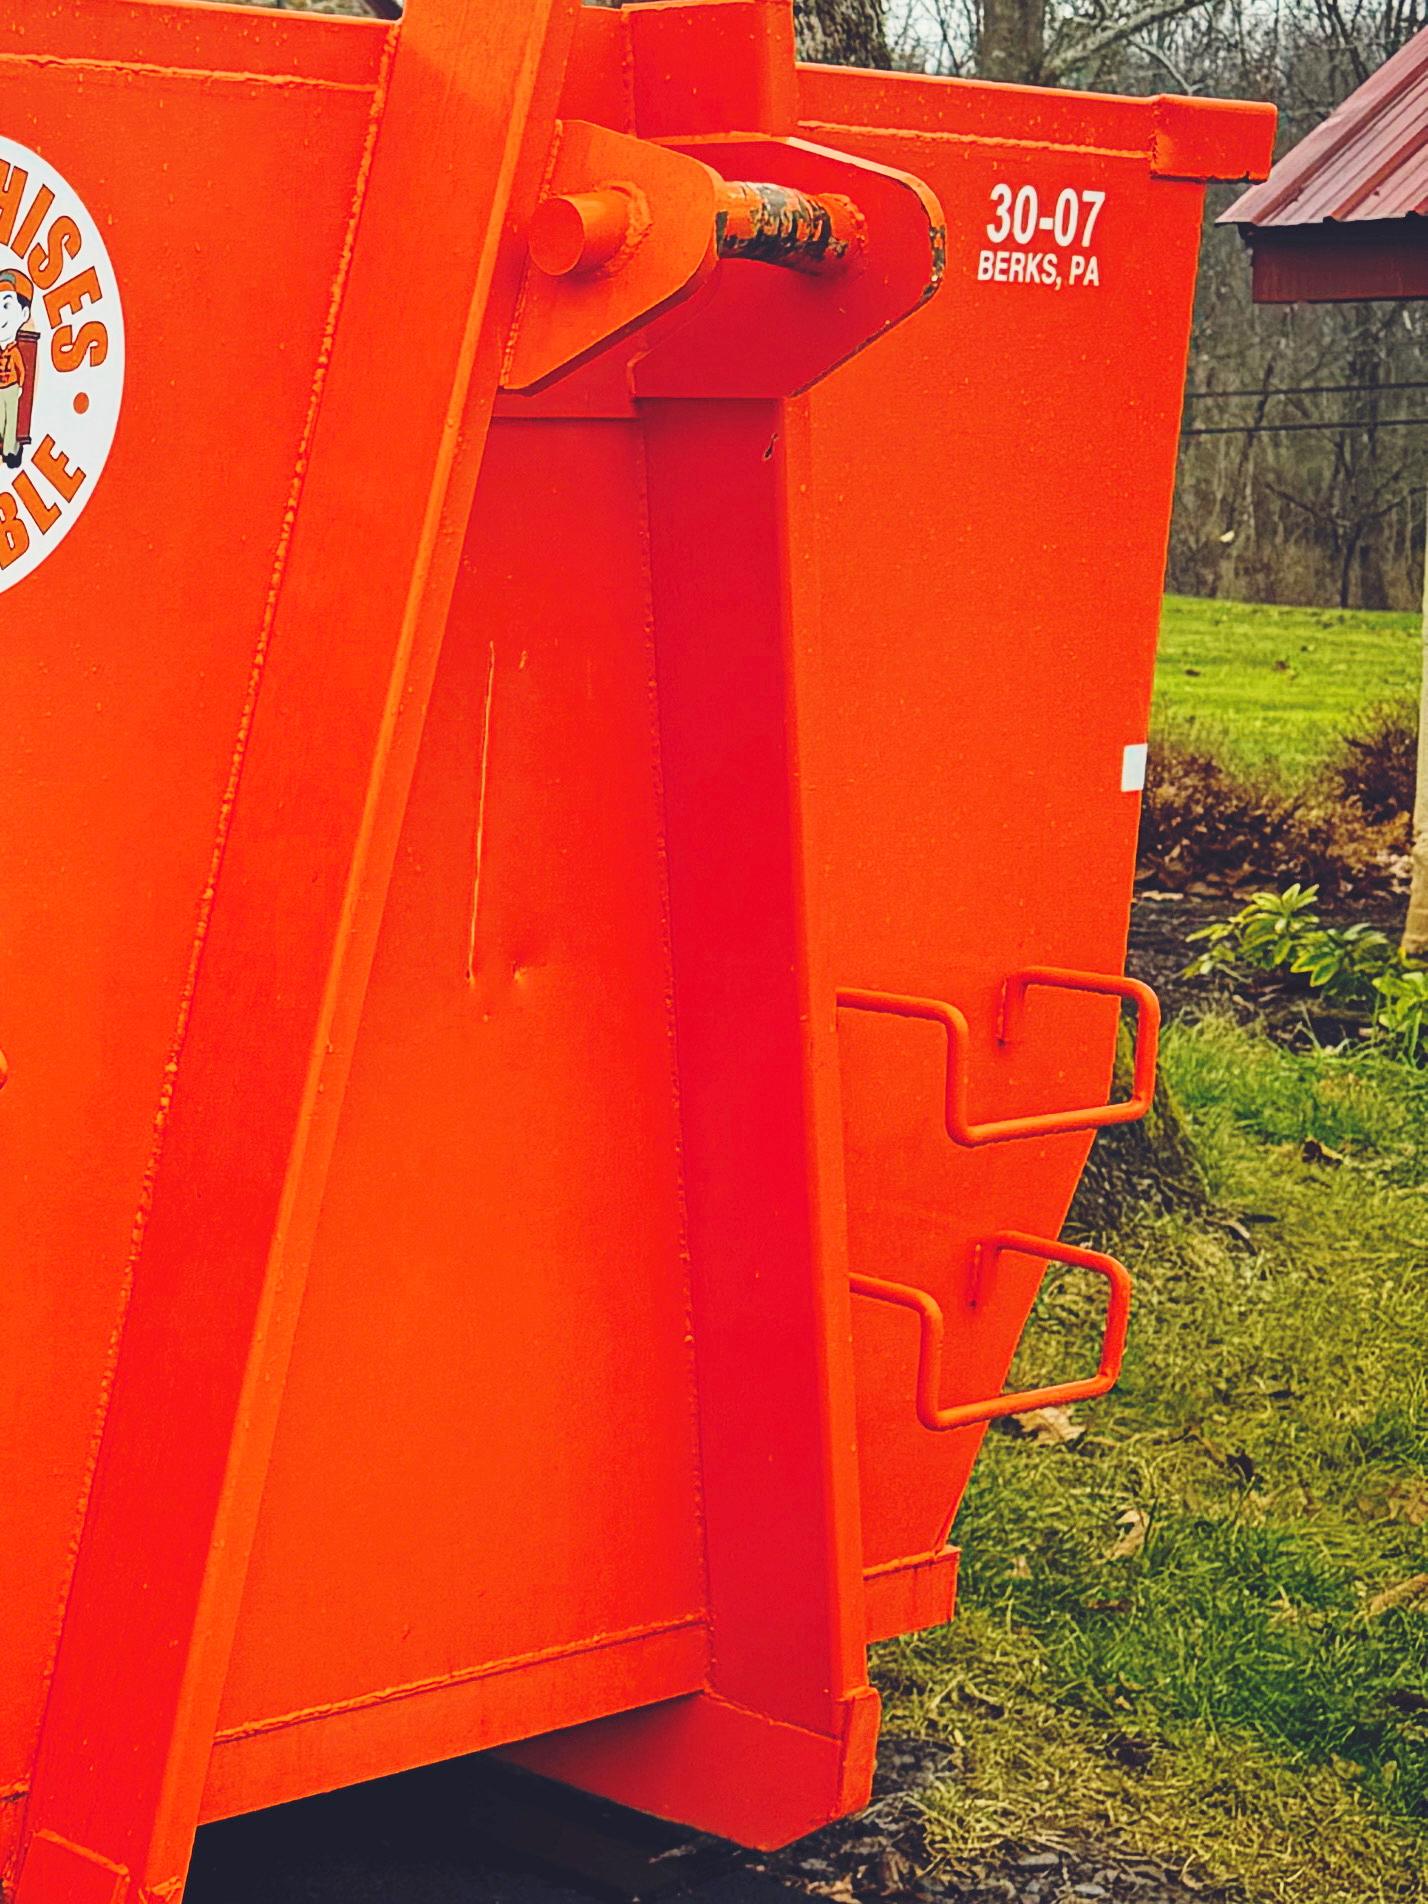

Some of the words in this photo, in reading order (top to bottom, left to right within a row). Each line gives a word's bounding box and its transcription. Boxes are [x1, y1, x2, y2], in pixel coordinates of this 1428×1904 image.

[986, 183, 1106, 247] 30-07
[977, 250, 1062, 291] BERKS,
[1068, 254, 1100, 287] PA
